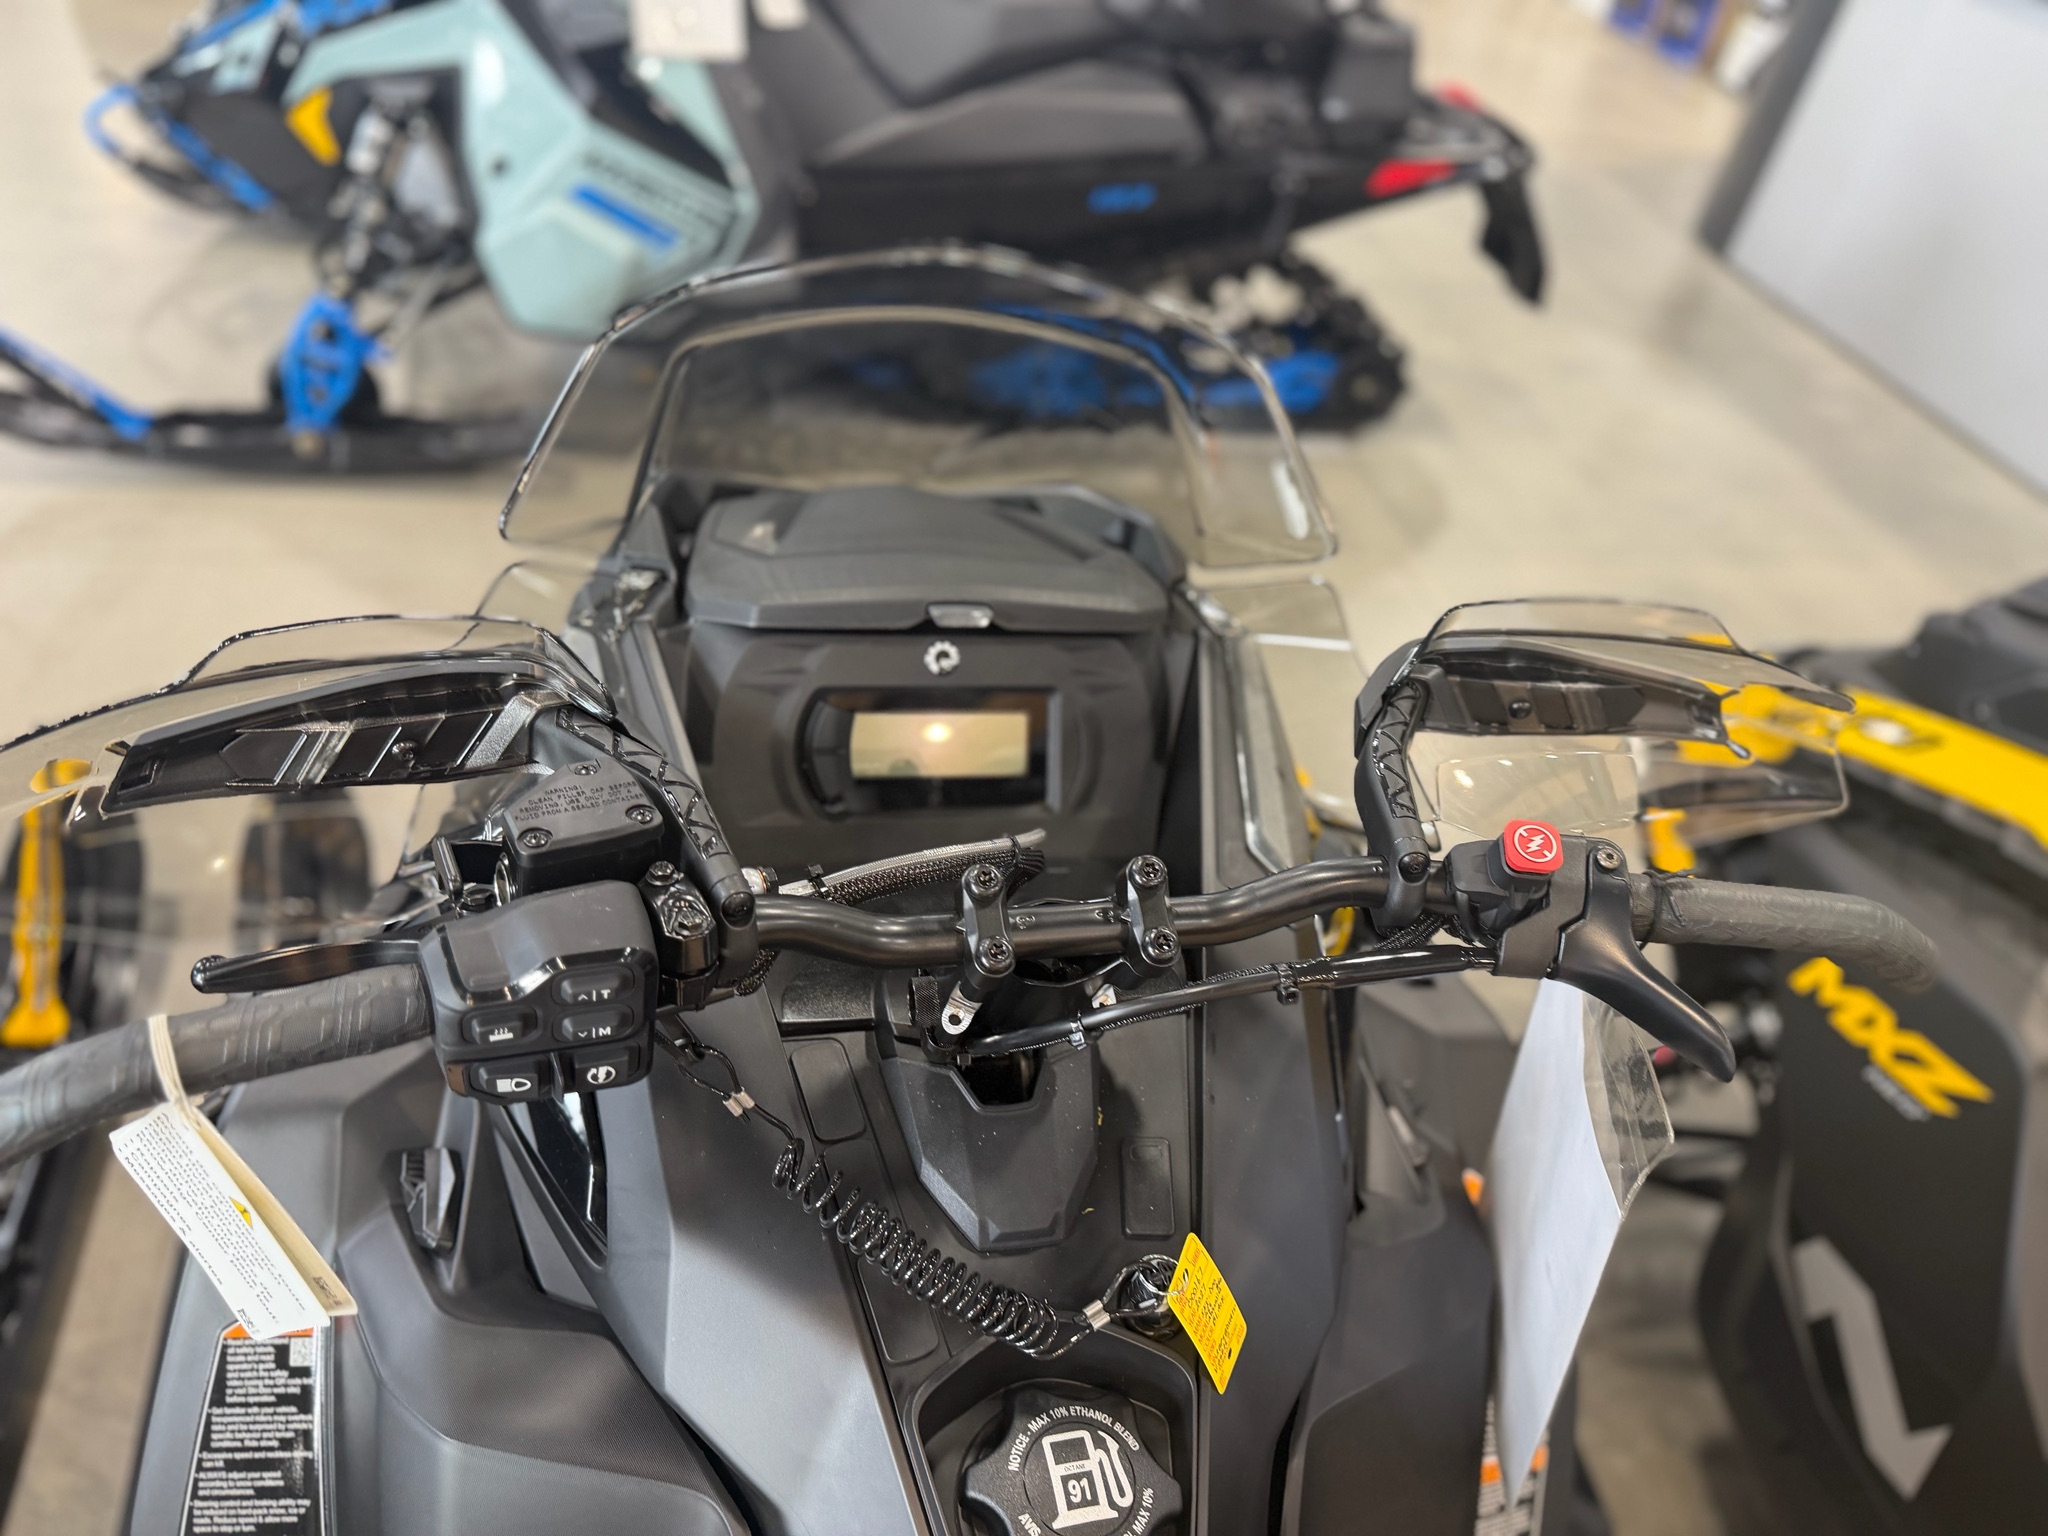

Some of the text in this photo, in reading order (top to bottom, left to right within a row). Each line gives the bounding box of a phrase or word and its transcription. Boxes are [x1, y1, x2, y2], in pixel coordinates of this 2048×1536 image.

[528, 780, 637, 806] CLEAN FILLER CAP BEFORE
[545, 785, 582, 796] WARNING:
[565, 799, 581, 807] USE
[584, 794, 604, 802] ONLY
[608, 789, 622, 798] DOT
[515, 812, 540, 822] FLUID
[542, 807, 562, 818] FROM
[571, 801, 600, 812] SEALED
[601, 793, 643, 806] CONTAINER
[161, 1112, 194, 1154] Avant
[1008, 1405, 1140, 1471] NOTICE MAX 10% ETHANOL BLEND
[1063, 1463, 1086, 1473] OCTANE
[1067, 1477, 1092, 1503] 91
[1131, 1487, 1154, 1534] MAX 10%
